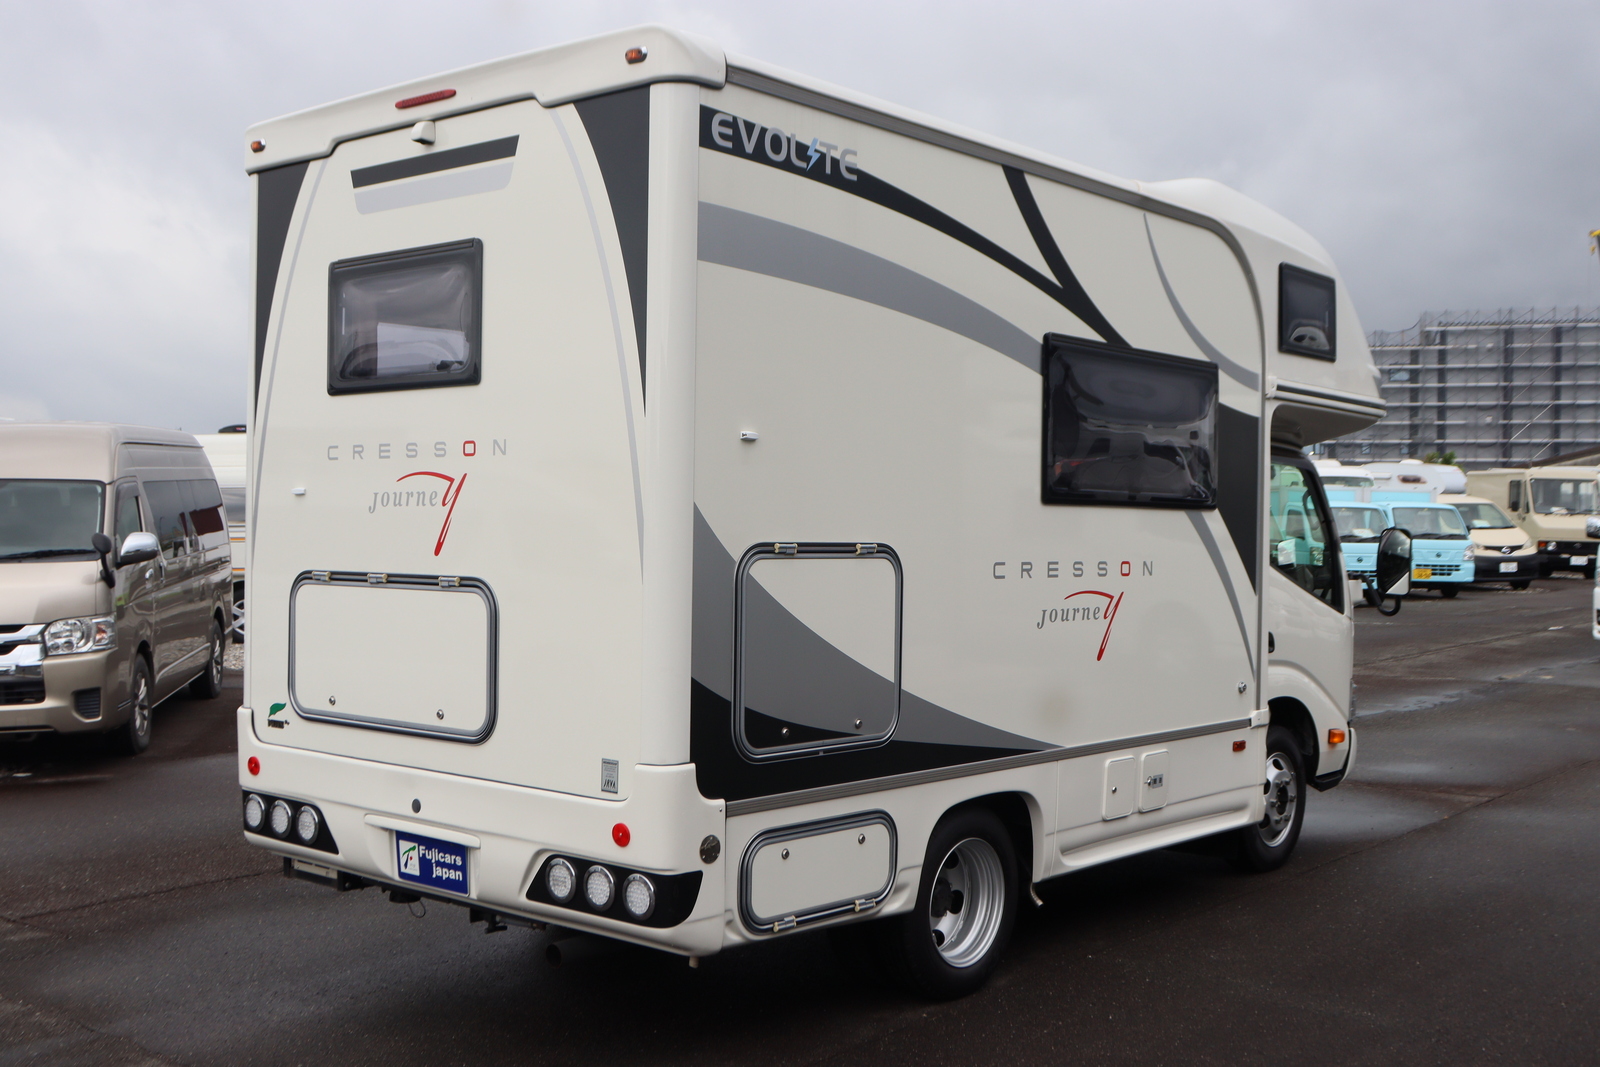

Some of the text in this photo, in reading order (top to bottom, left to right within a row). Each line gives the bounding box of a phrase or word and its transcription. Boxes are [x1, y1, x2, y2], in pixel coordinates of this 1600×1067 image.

[327, 438, 507, 461] CRESSON
[993, 560, 1153, 580] CRESSON
[418, 845, 463, 866] Fujicars
